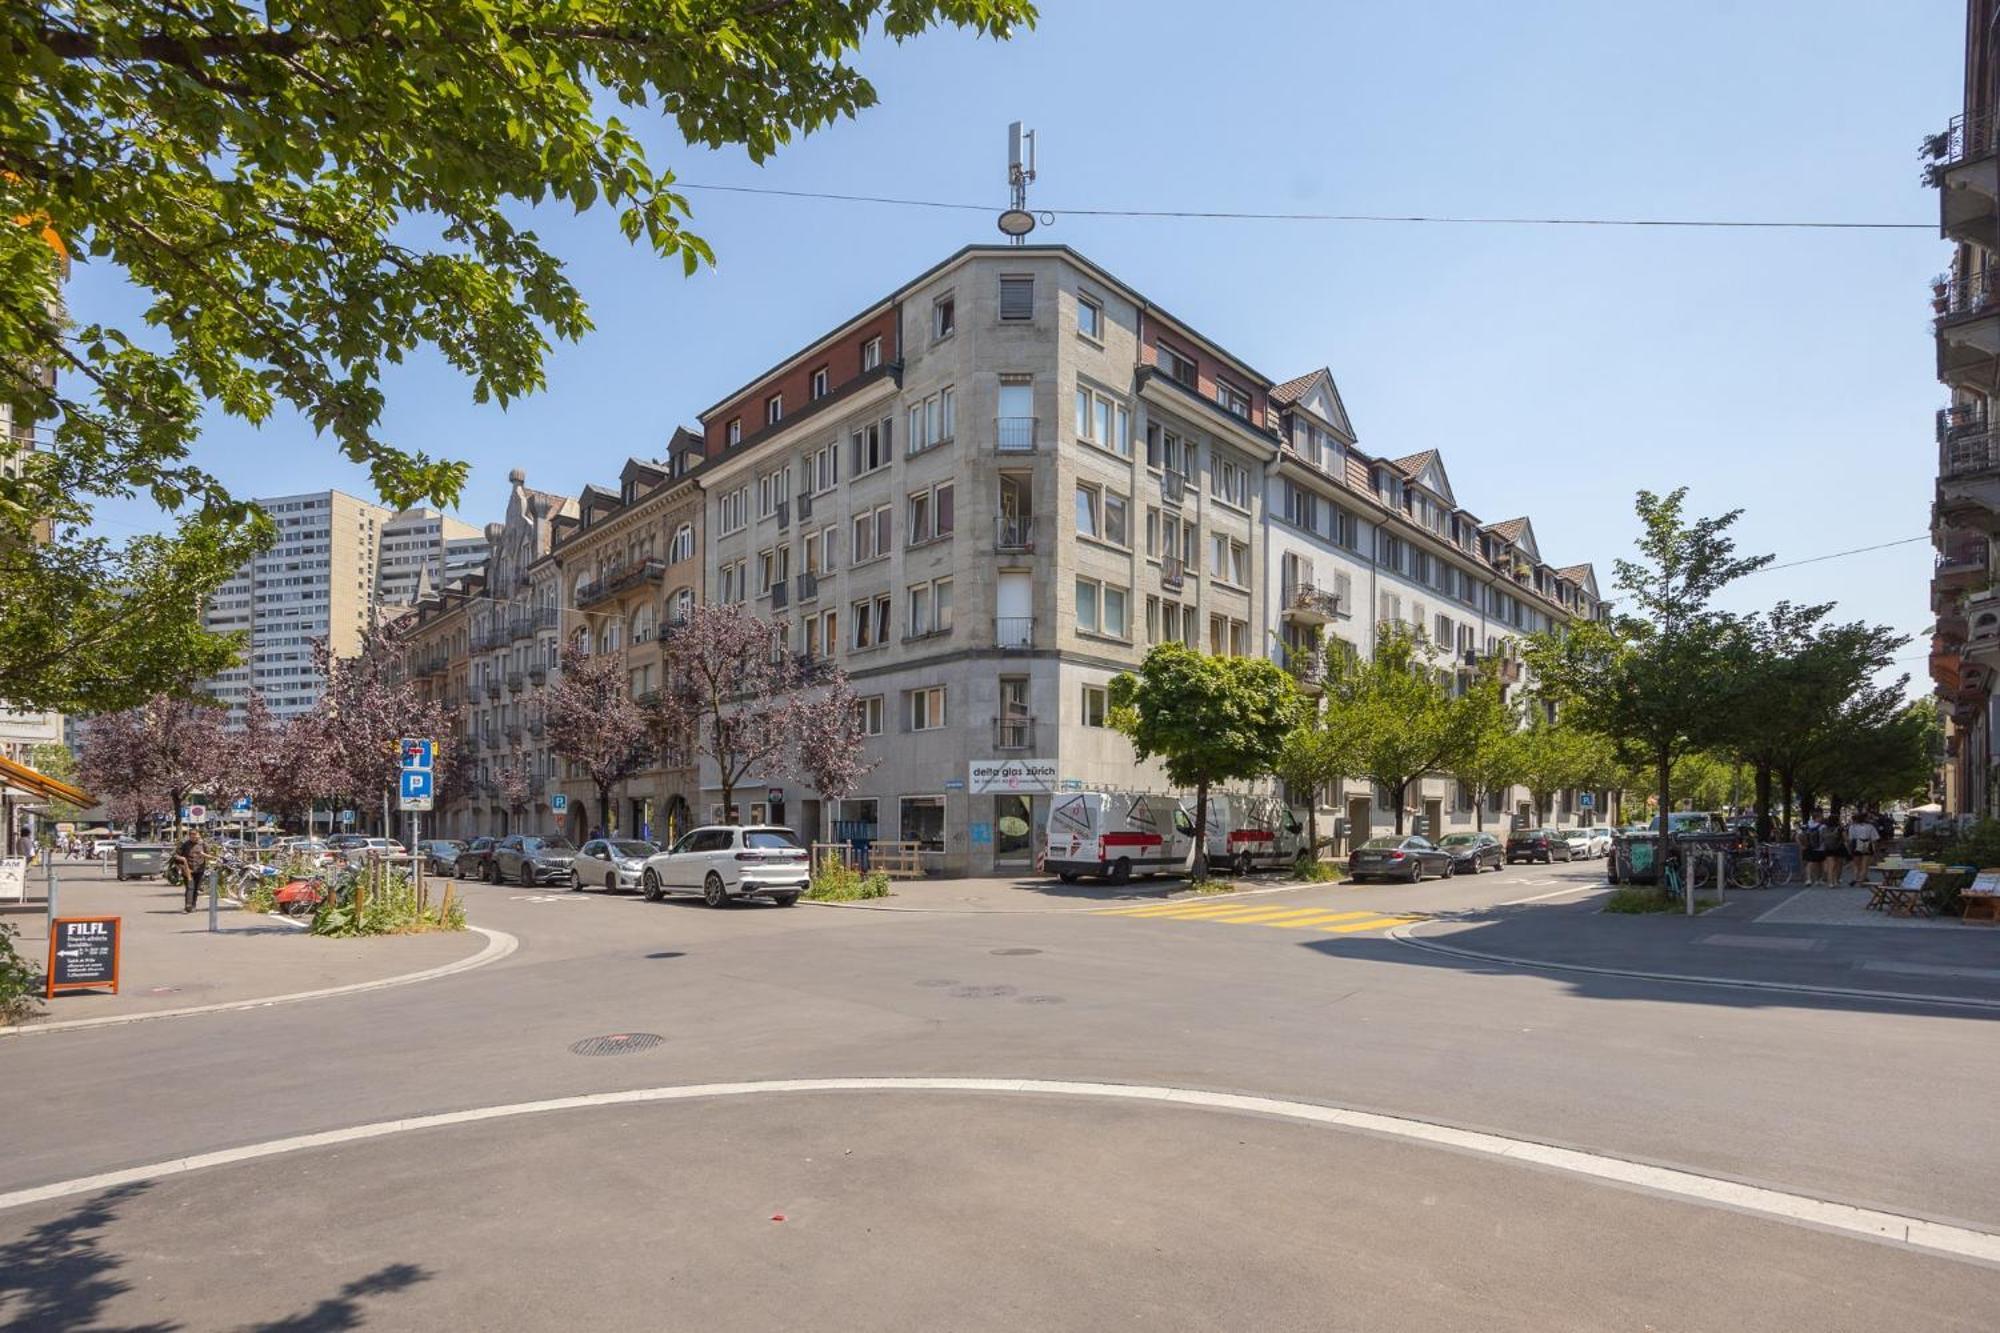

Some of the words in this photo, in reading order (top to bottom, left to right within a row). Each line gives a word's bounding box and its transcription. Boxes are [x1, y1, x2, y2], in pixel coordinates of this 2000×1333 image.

[973, 767, 1000, 777] delta
[1002, 767, 1023, 779] glas
[1026, 766, 1055, 776] zürich
[409, 776, 424, 792] P
[68, 923, 107, 934] FILFL
